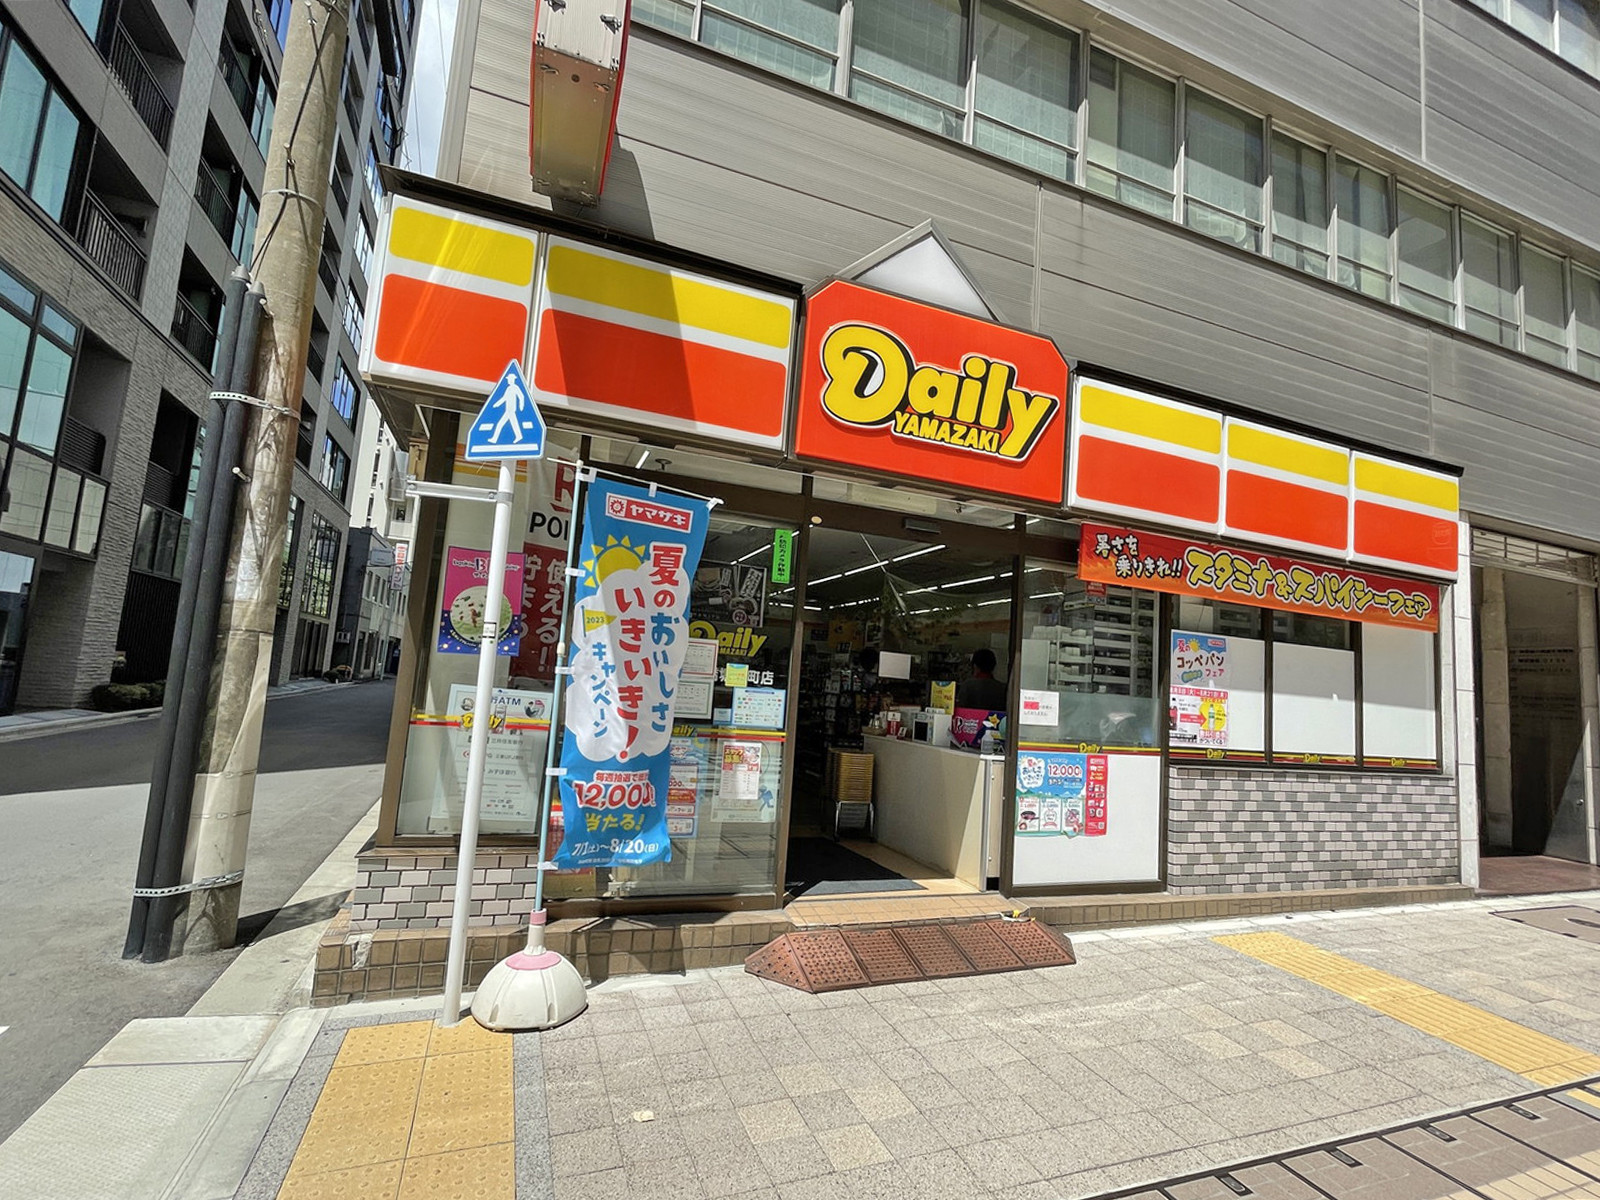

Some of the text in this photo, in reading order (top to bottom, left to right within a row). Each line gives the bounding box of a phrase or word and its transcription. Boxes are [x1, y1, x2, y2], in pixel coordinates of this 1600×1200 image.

[822, 322, 1059, 460] Daily
[894, 410, 1002, 454] YAMAZAKI
[1095, 533, 1139, 558] 暑さを
[1116, 554, 1183, 579] 乗りきれ!!
[1185, 548, 1433, 620] スタミナ&スパイシーフェア
[648, 544, 687, 733] 夏のおいしさ
[614, 587, 652, 760] いきいき!
[1176, 653, 1224, 669] コッペパン
[1205, 668, 1225, 677] フェア
[591, 642, 616, 738] キャンペーン
[586, 813, 645, 832] 当たる!
